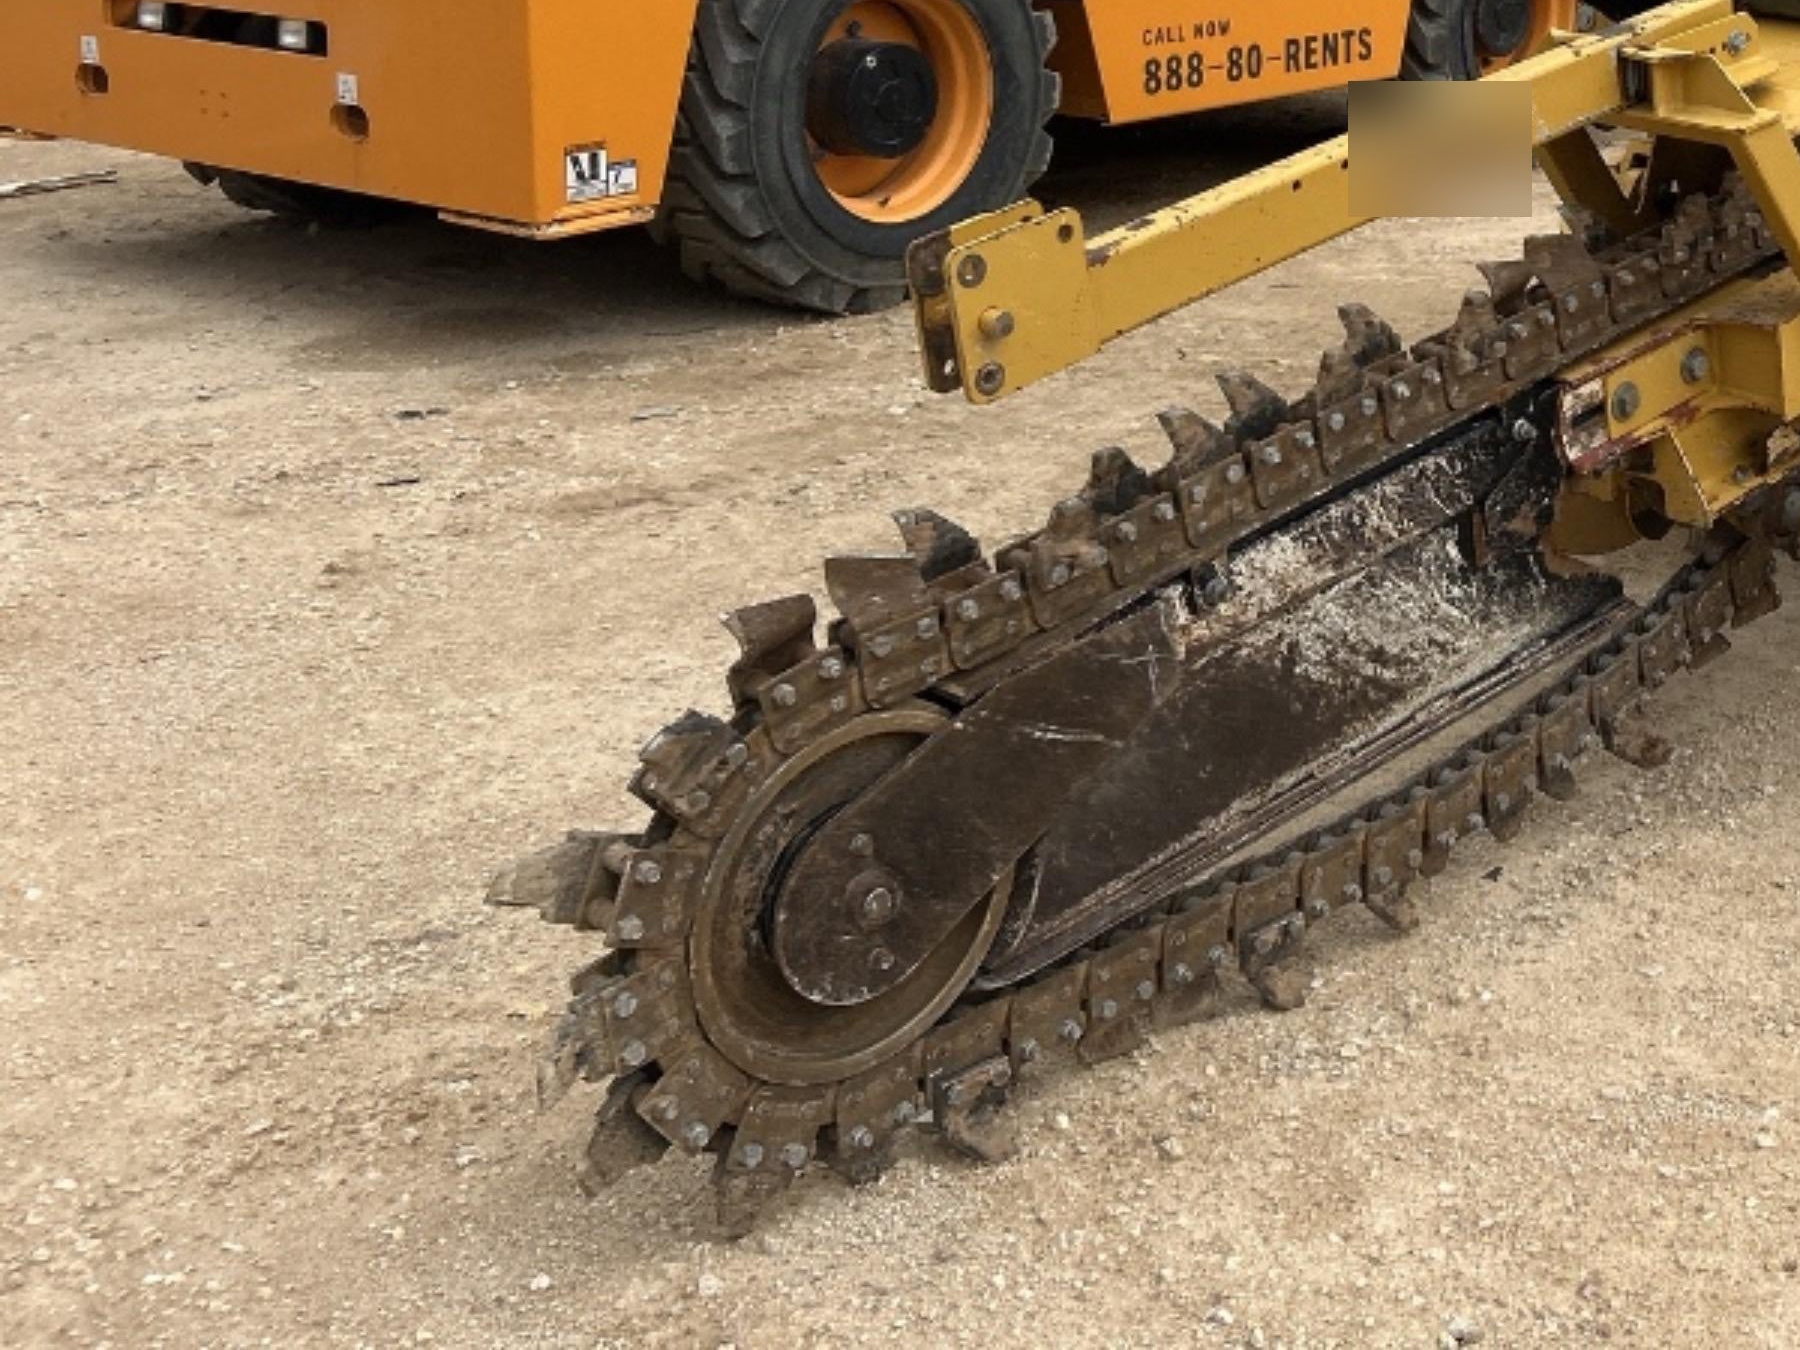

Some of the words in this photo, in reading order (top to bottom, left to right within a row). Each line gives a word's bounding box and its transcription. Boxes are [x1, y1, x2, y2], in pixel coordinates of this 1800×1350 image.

[1142, 24, 1185, 46] CALL
[1193, 18, 1231, 40] NOW
[1144, 27, 1373, 96] 888-80-RENTS
